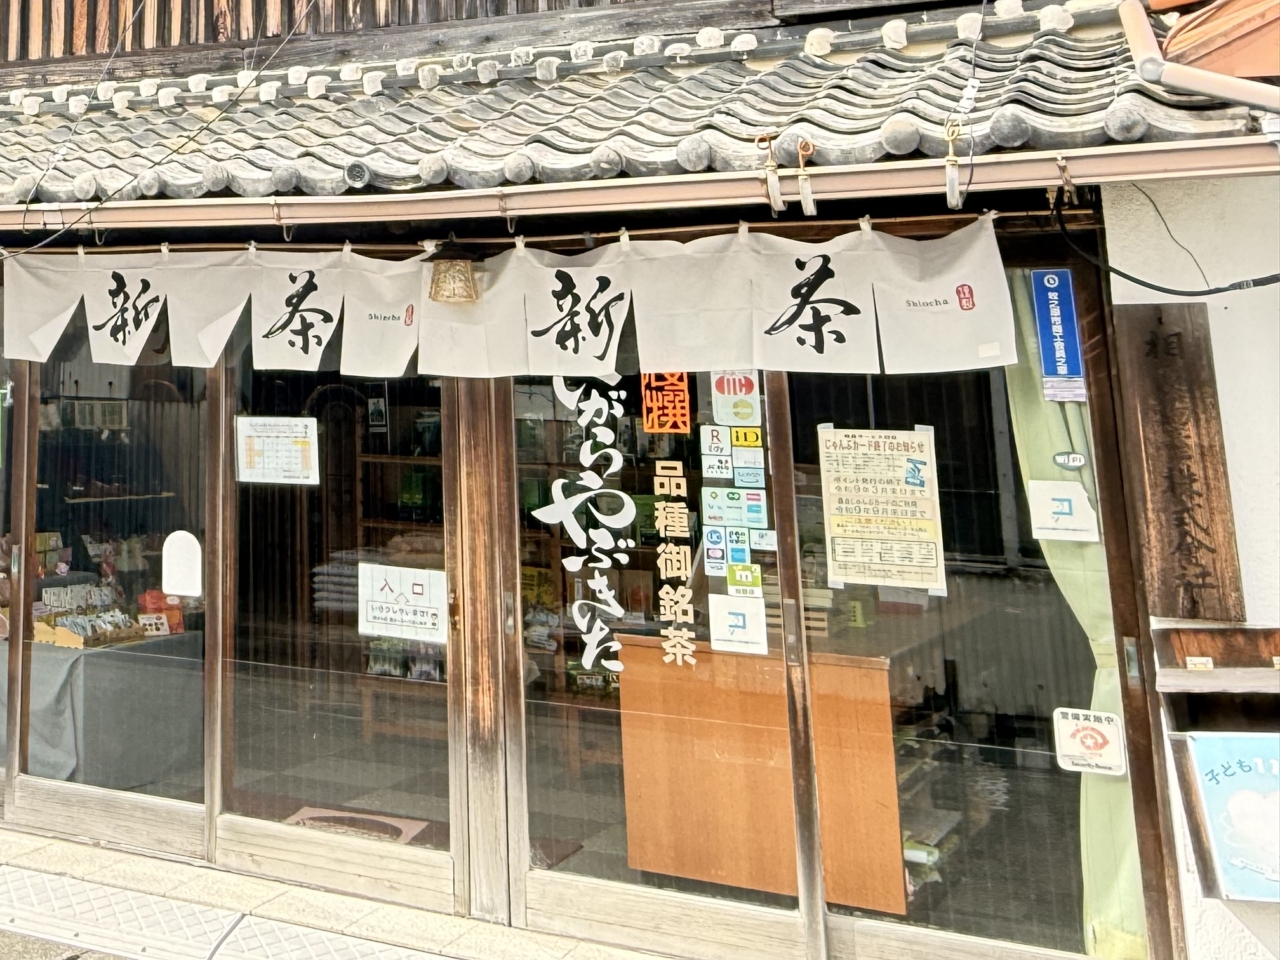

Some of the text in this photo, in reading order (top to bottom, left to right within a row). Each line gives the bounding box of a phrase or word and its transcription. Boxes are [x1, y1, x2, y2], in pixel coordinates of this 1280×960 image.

[531, 254, 861, 361] 新茶
[653, 460, 697, 666] 品種御銘茶
